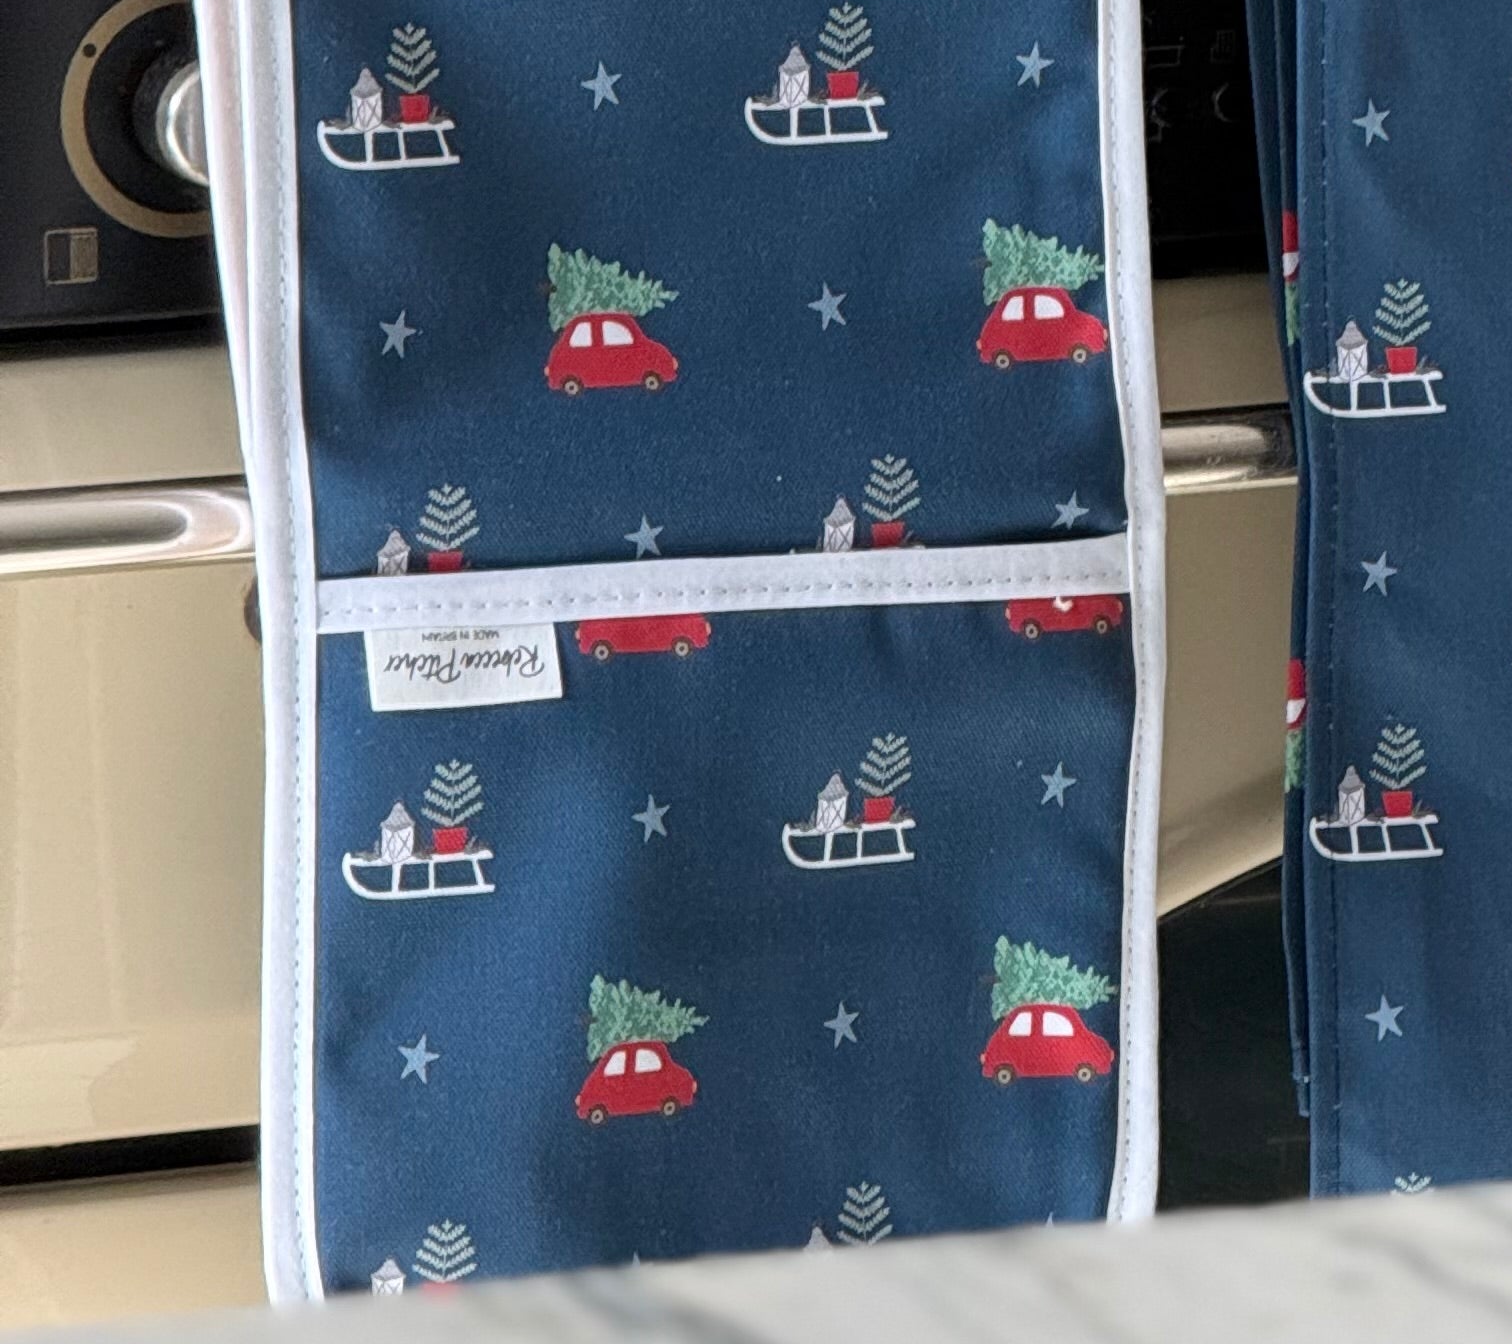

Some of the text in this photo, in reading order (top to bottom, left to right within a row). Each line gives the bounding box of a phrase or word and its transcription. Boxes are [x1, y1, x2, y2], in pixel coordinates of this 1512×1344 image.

[421, 630, 499, 642] MADE IN BRITAIN
[383, 644, 545, 684] Rebecca Pitcher
